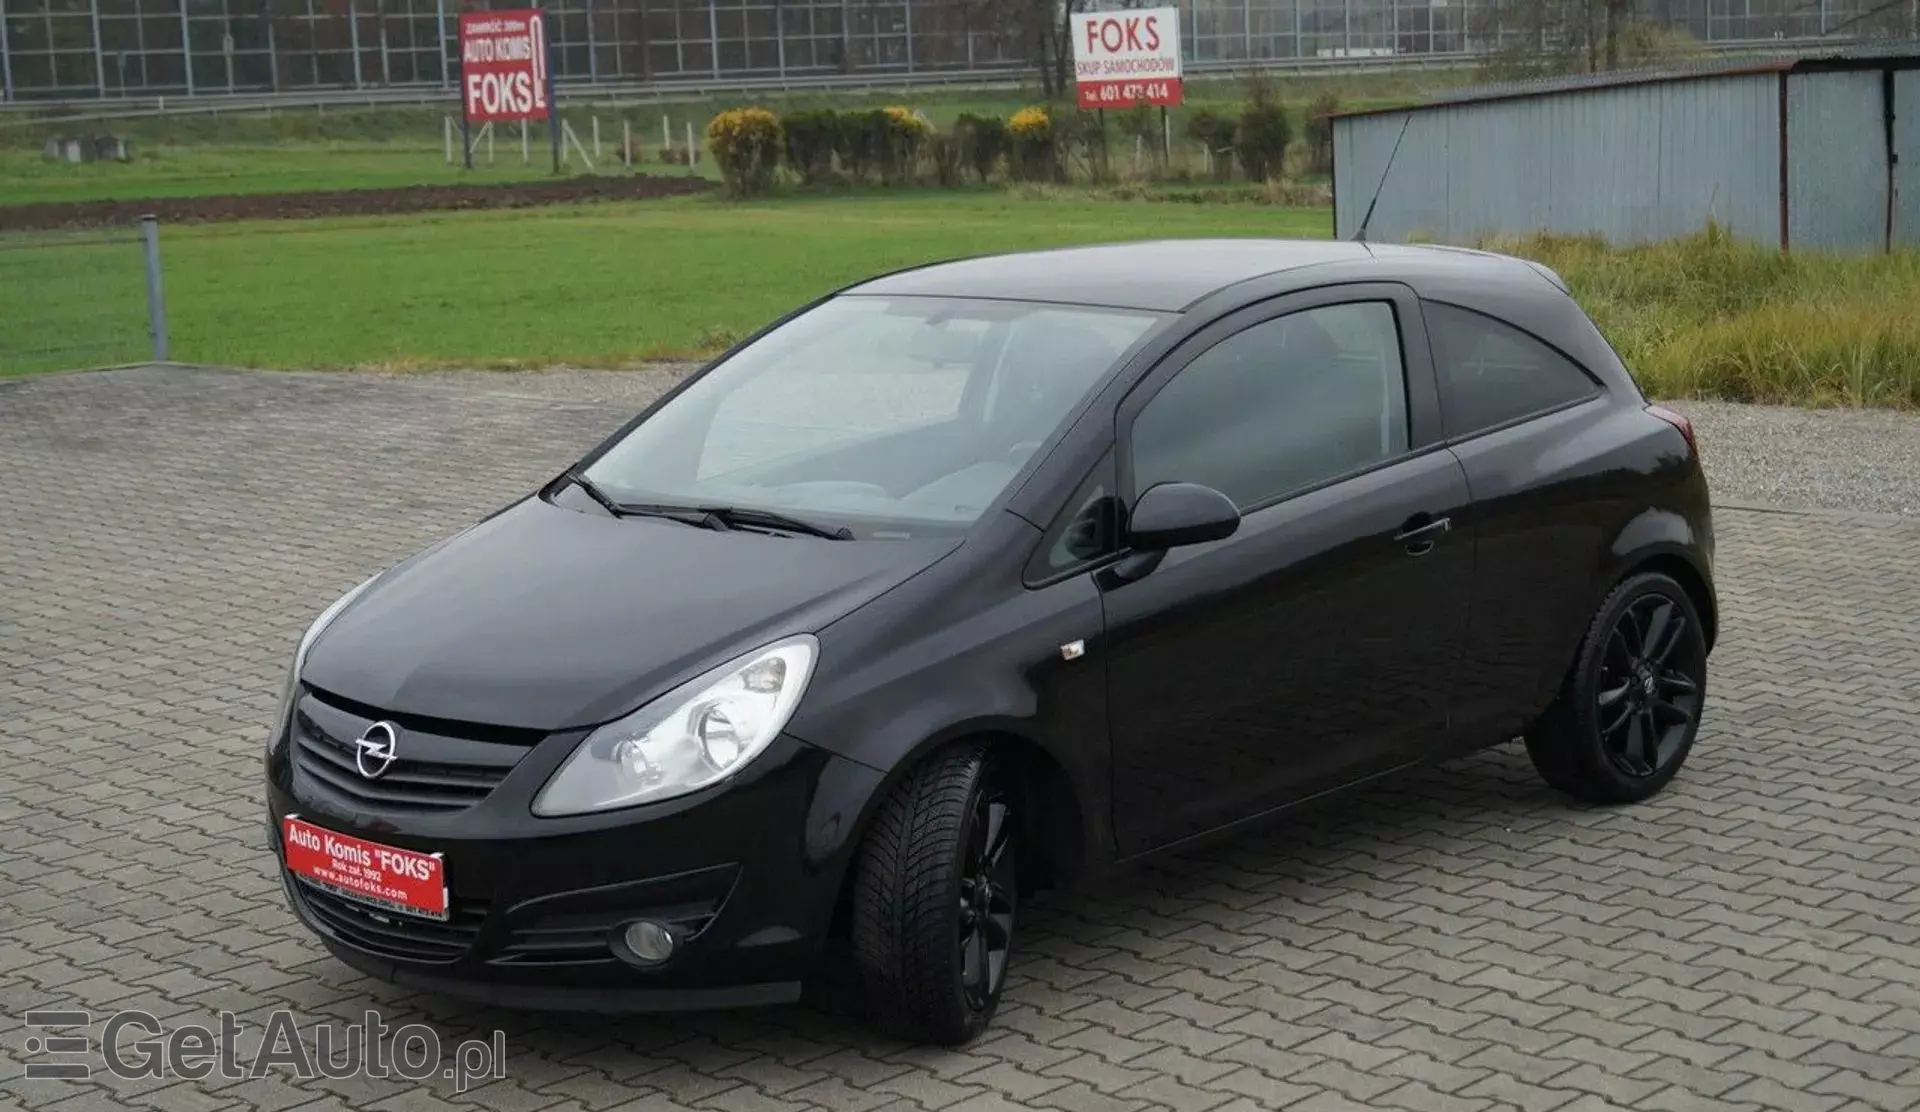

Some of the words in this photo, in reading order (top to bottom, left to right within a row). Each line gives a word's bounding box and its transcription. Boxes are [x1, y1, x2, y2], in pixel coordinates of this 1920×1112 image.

[464, 37, 494, 63] AUTO
[495, 35, 530, 61] KOMIS
[1086, 15, 1160, 54] FOKS
[1077, 61, 1101, 76] SKUP
[467, 69, 533, 114] FOKS
[1100, 84, 1120, 101] 601
[1146, 82, 1169, 99] 414
[289, 824, 320, 851] Auto
[324, 833, 371, 867] Komis
[374, 849, 435, 881] "FOKS"
[313, 866, 408, 900] www.autofoks.com
